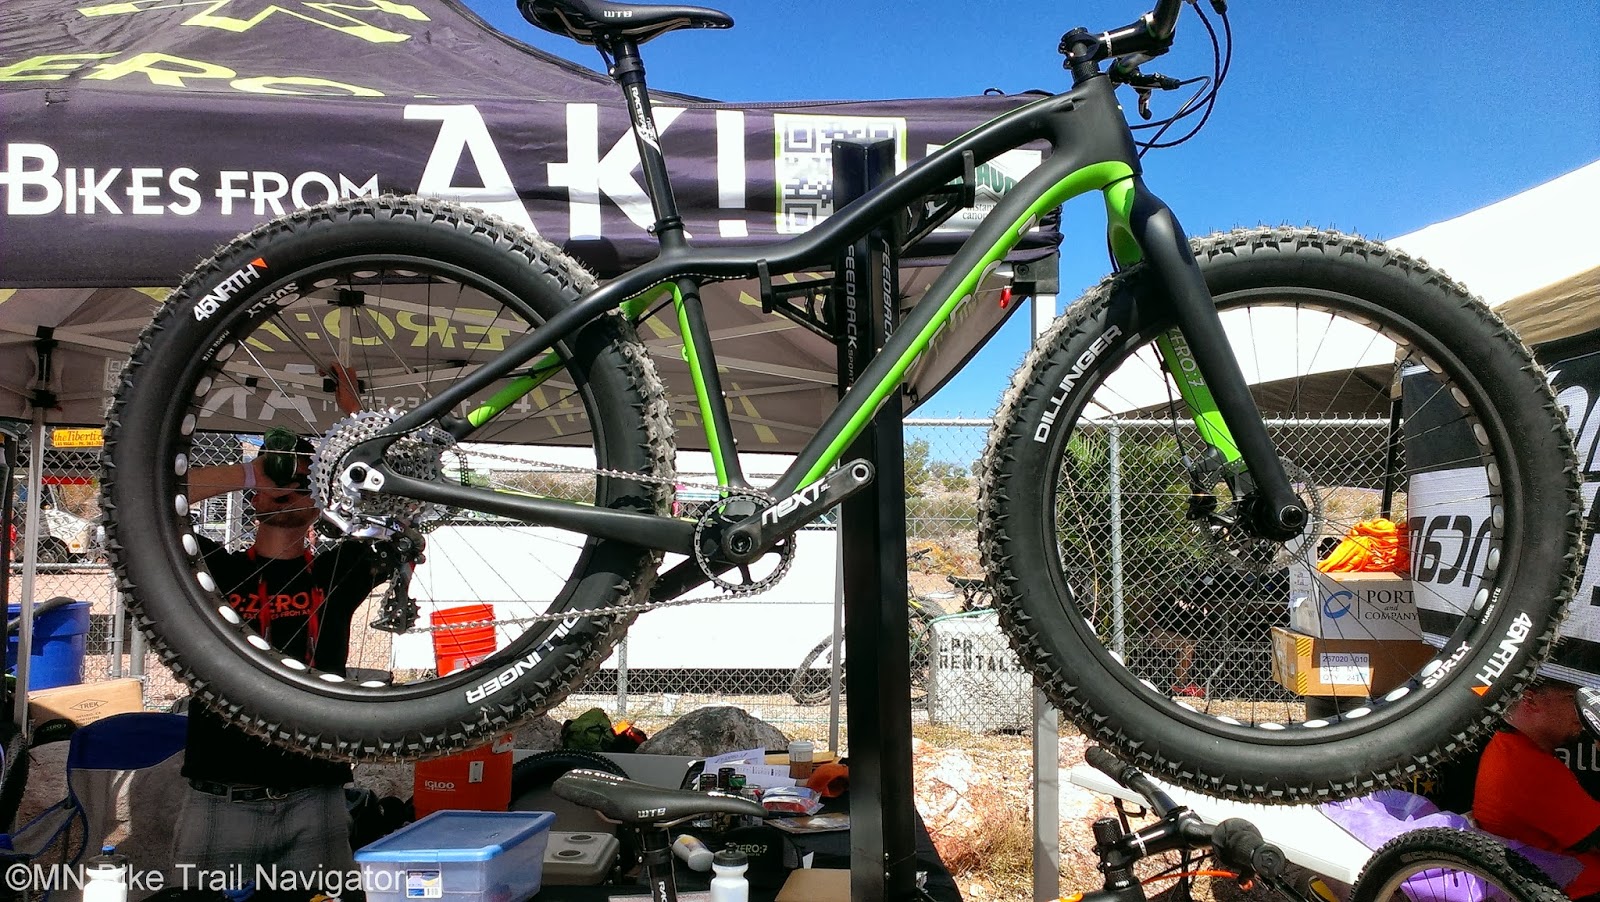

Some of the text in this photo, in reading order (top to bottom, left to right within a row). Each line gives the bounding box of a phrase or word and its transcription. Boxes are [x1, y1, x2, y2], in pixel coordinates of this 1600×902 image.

[603, 10, 633, 18] WTB
[215, 171, 380, 216] FROM
[404, 102, 749, 241] AK!
[193, 263, 261, 322] 45NRTH
[244, 281, 299, 319] SURLY
[845, 244, 858, 349] FEEDBACK
[1033, 324, 1123, 444] DILLINGER
[820, 484, 832, 493] SL
[1366, 589, 1414, 604] PORT
[1491, 586, 1502, 604] LITE
[1364, 611, 1418, 620] COMPANY
[465, 606, 582, 704] DILLINGER
[1474, 612, 1533, 687] 45NRTH
[1421, 640, 1472, 689] SURLY
[80, 701, 99, 711] TREK
[424, 780, 455, 790] IGLOO
[637, 807, 667, 819] WTB
